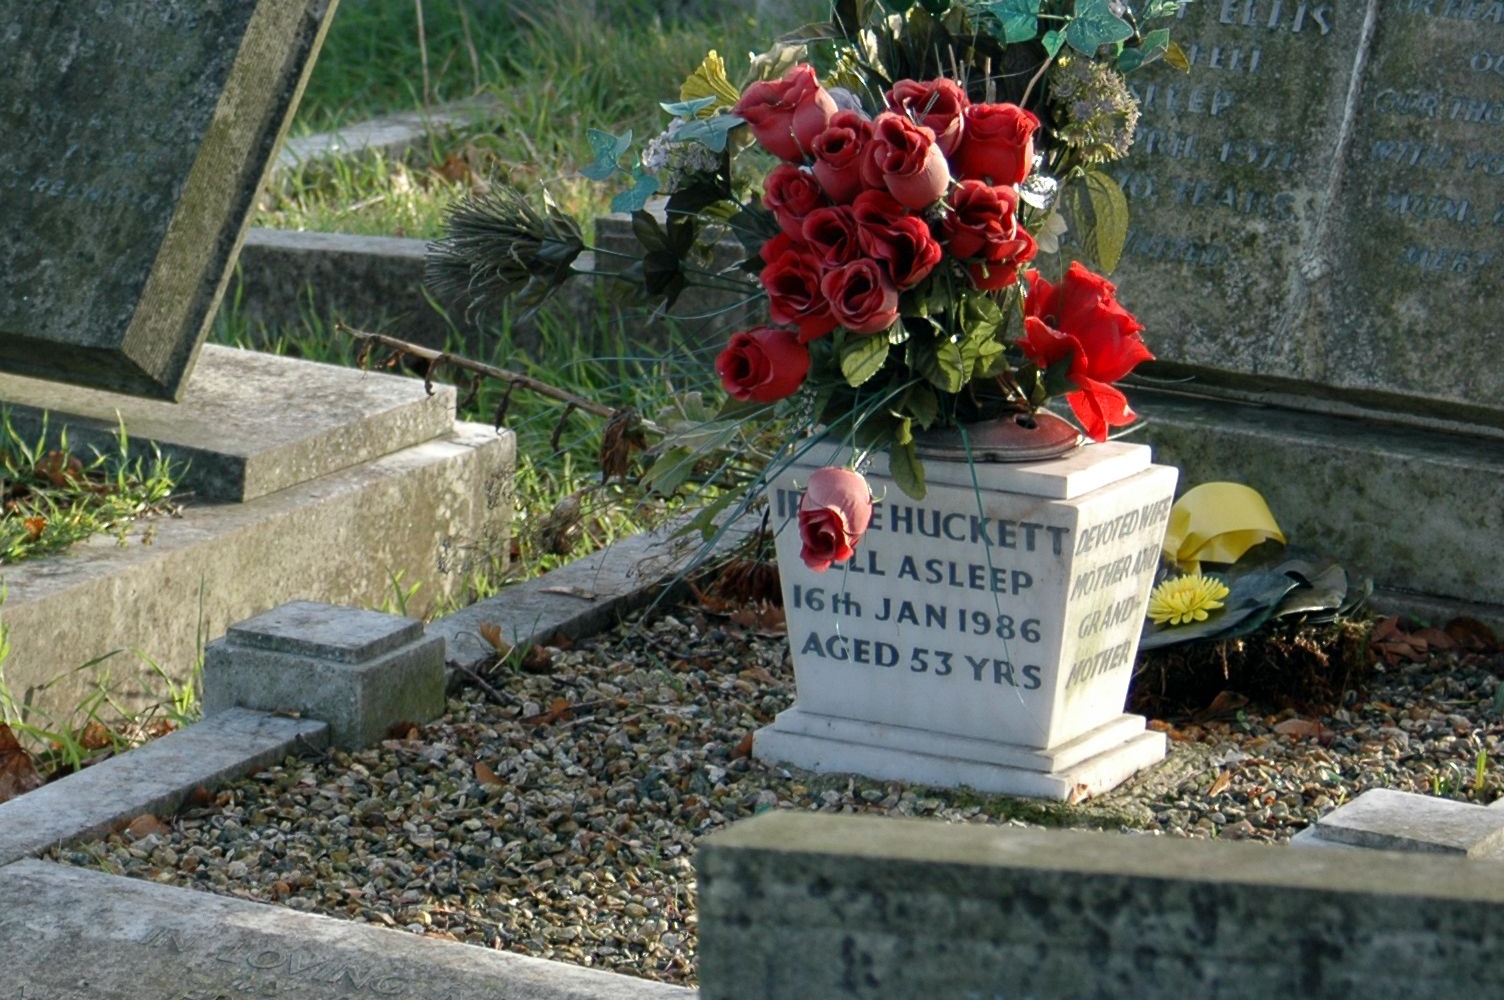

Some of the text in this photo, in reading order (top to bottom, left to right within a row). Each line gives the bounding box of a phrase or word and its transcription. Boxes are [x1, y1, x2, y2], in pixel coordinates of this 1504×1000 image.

[1128, 81, 1237, 117] SLEEP
[890, 502, 1071, 557] HUCKETT
[1075, 494, 1173, 557] DEVOTED WIFE
[897, 554, 1034, 596] ASLEEP
[1070, 542, 1161, 602] MOTHER AND
[793, 584, 1042, 644] 16th JAN 1986
[800, 631, 1043, 691] AGED 53 YRS
[1065, 639, 1132, 691] MOTHER
